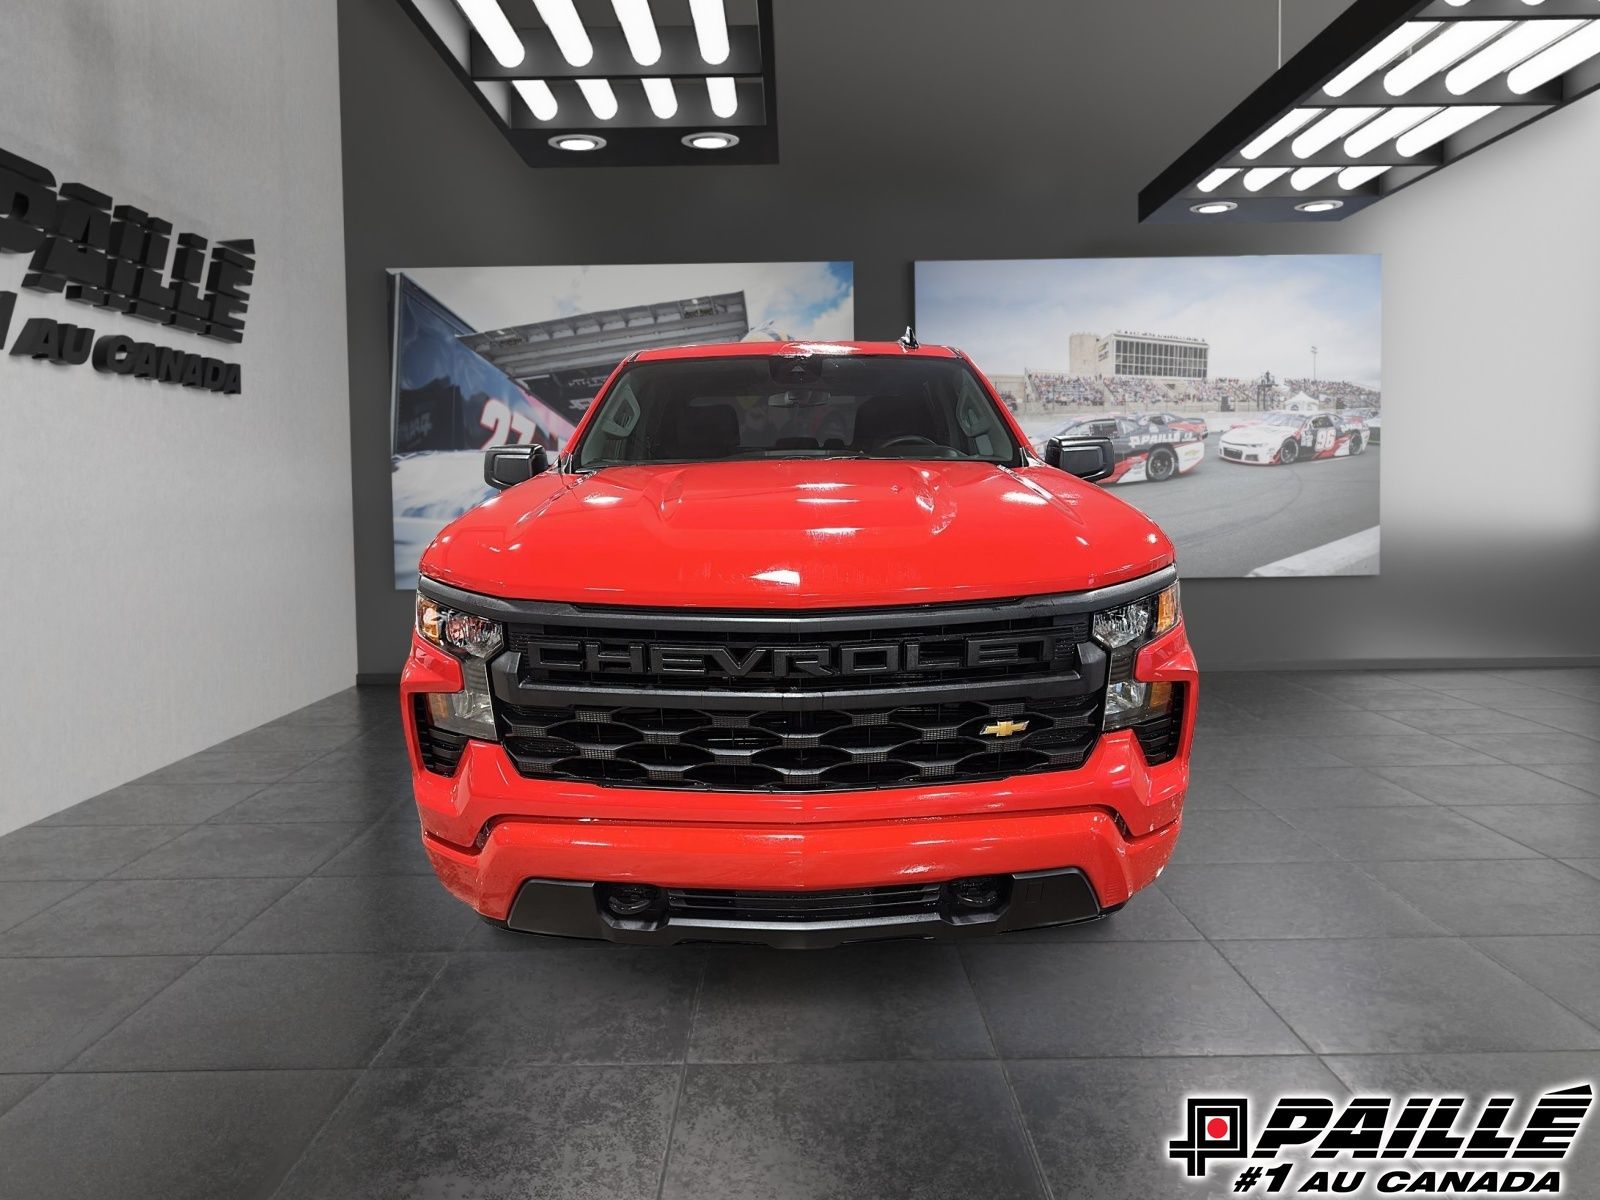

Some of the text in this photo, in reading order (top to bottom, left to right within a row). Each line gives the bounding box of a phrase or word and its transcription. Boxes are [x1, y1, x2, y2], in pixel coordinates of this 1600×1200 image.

[9, 318, 95, 364] AU
[92, 334, 242, 394] CANADA
[1315, 428, 1336, 452] 96
[527, 635, 1056, 678] CHEVROLET
